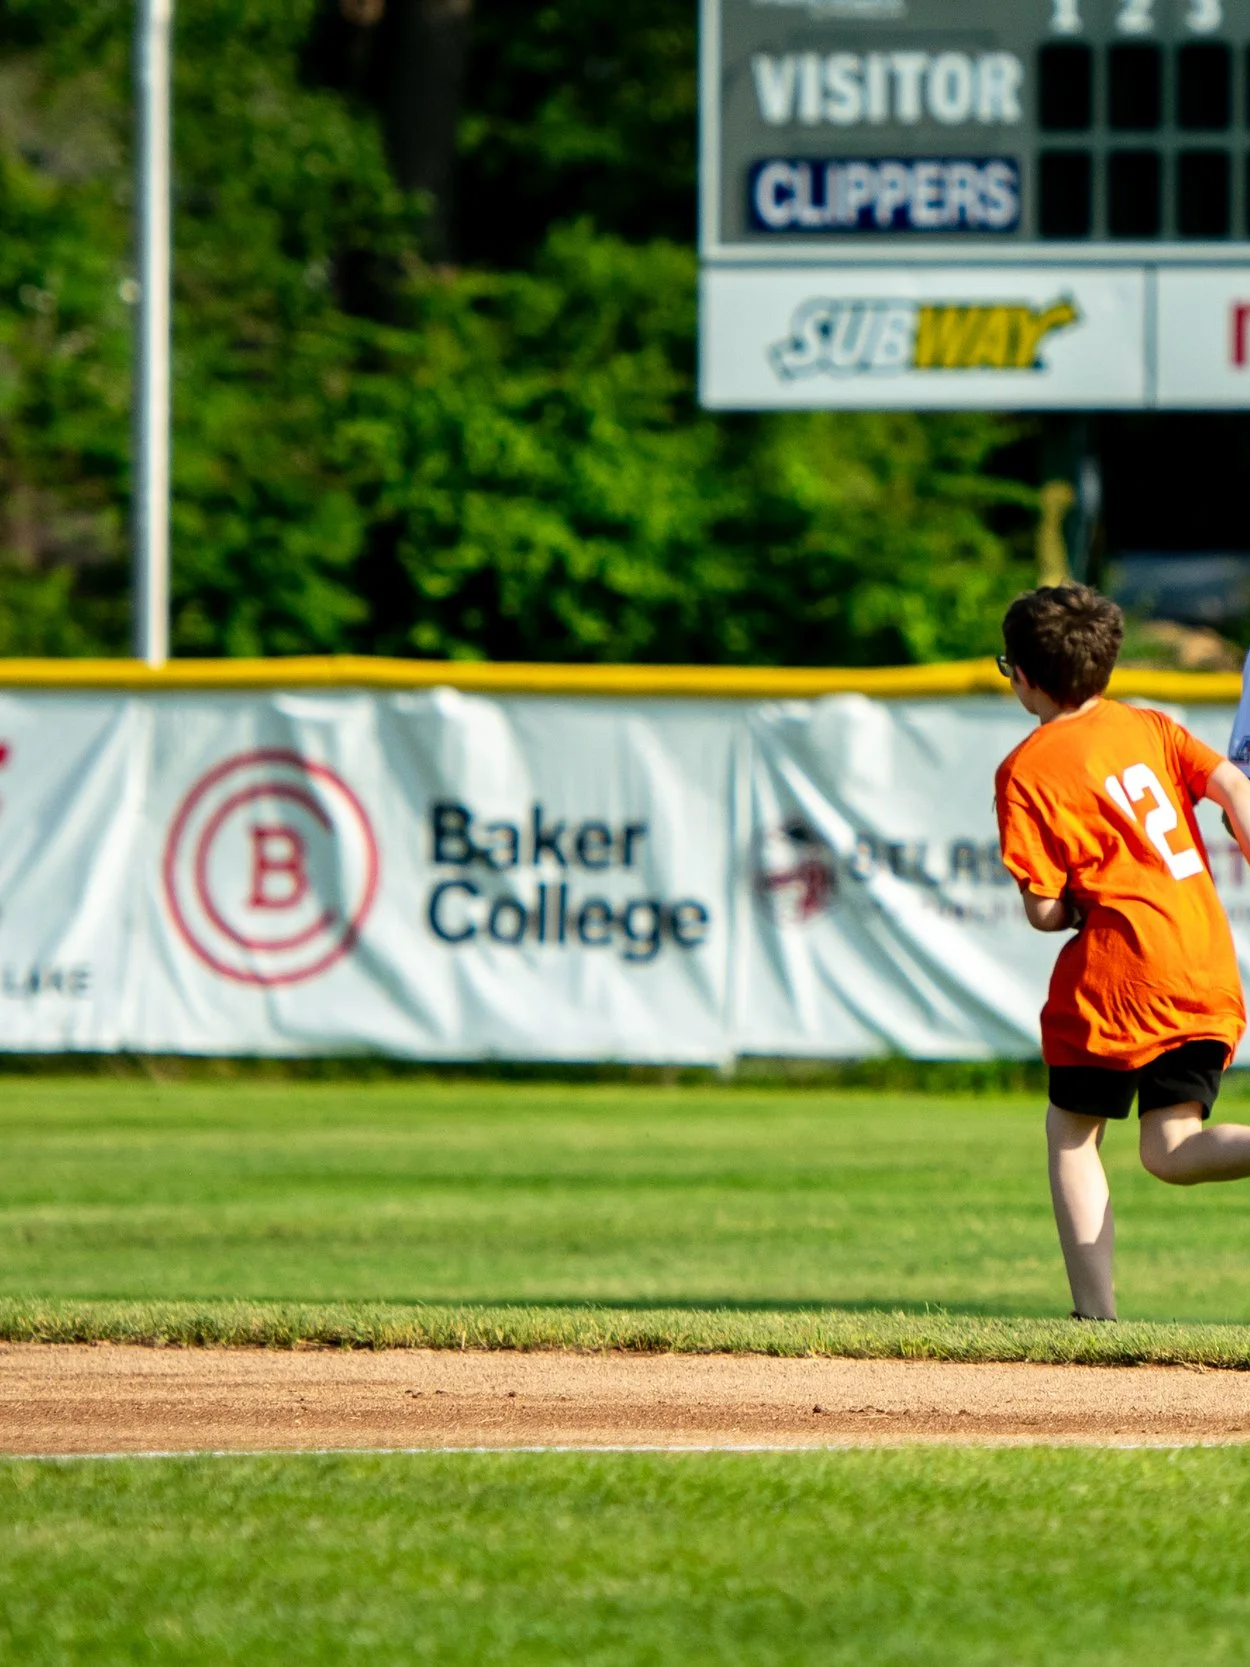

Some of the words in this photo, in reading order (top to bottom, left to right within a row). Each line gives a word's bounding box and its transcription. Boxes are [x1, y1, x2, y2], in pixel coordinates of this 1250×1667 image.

[753, 52, 1022, 124] VISITOR
[754, 161, 1018, 230] CLIPPERS
[769, 291, 1083, 382] SUBWAY
[428, 804, 647, 866] Baker
[1104, 762, 1204, 881] 12
[248, 826, 310, 911] B
[428, 880, 710, 962] College
